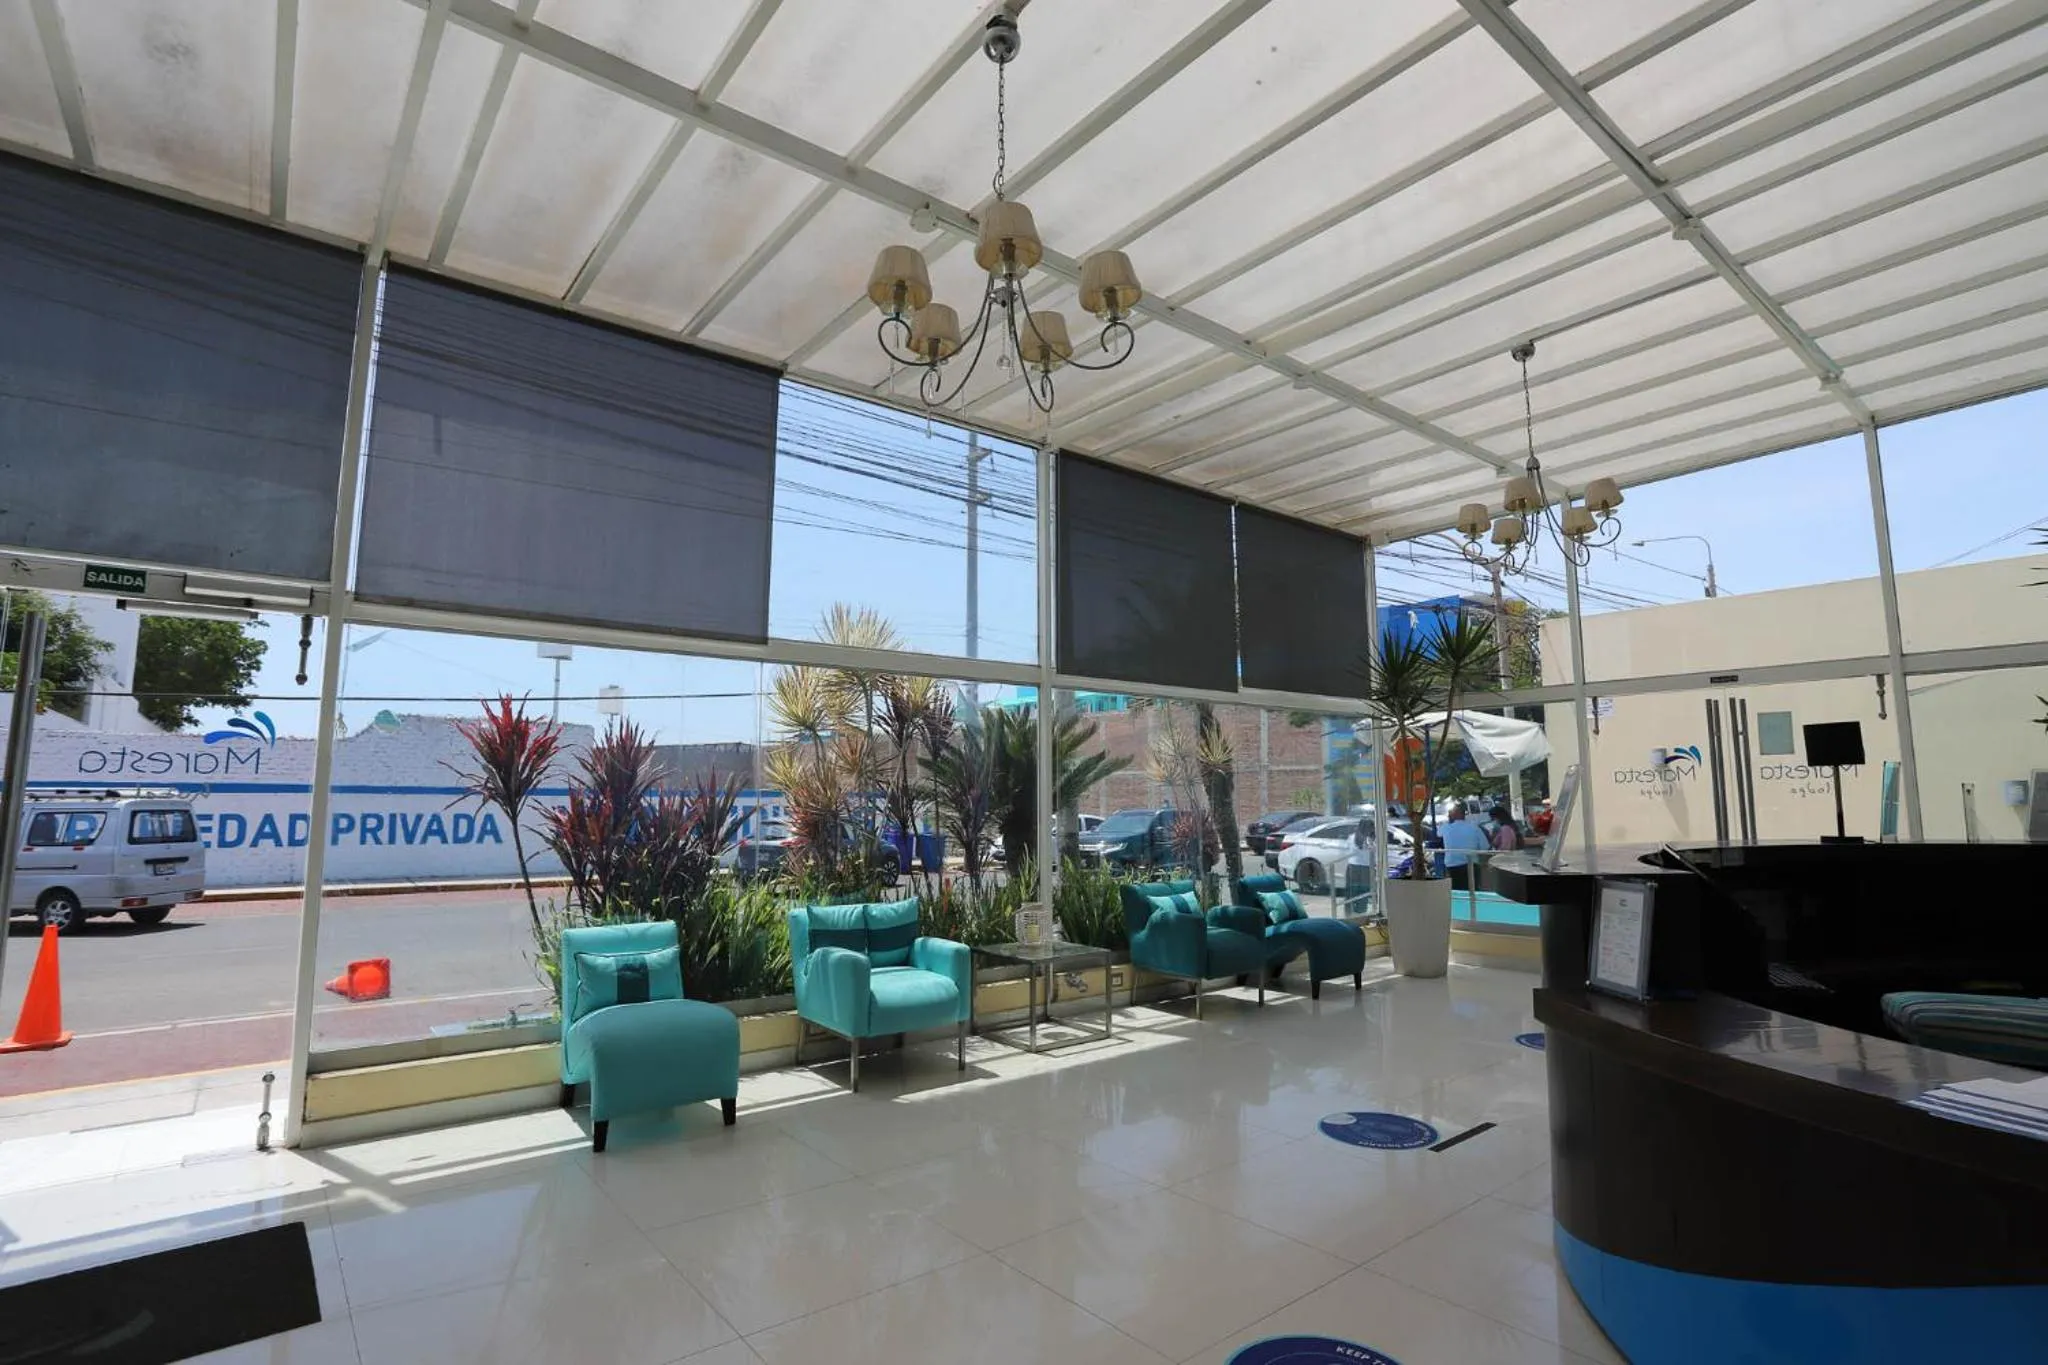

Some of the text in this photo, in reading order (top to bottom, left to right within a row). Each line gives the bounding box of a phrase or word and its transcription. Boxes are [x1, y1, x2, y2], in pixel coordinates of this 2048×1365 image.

[86, 571, 144, 587] SALIDA
[330, 812, 504, 847] PRIVADA
[1335, 1346, 1371, 1360] KEEP
